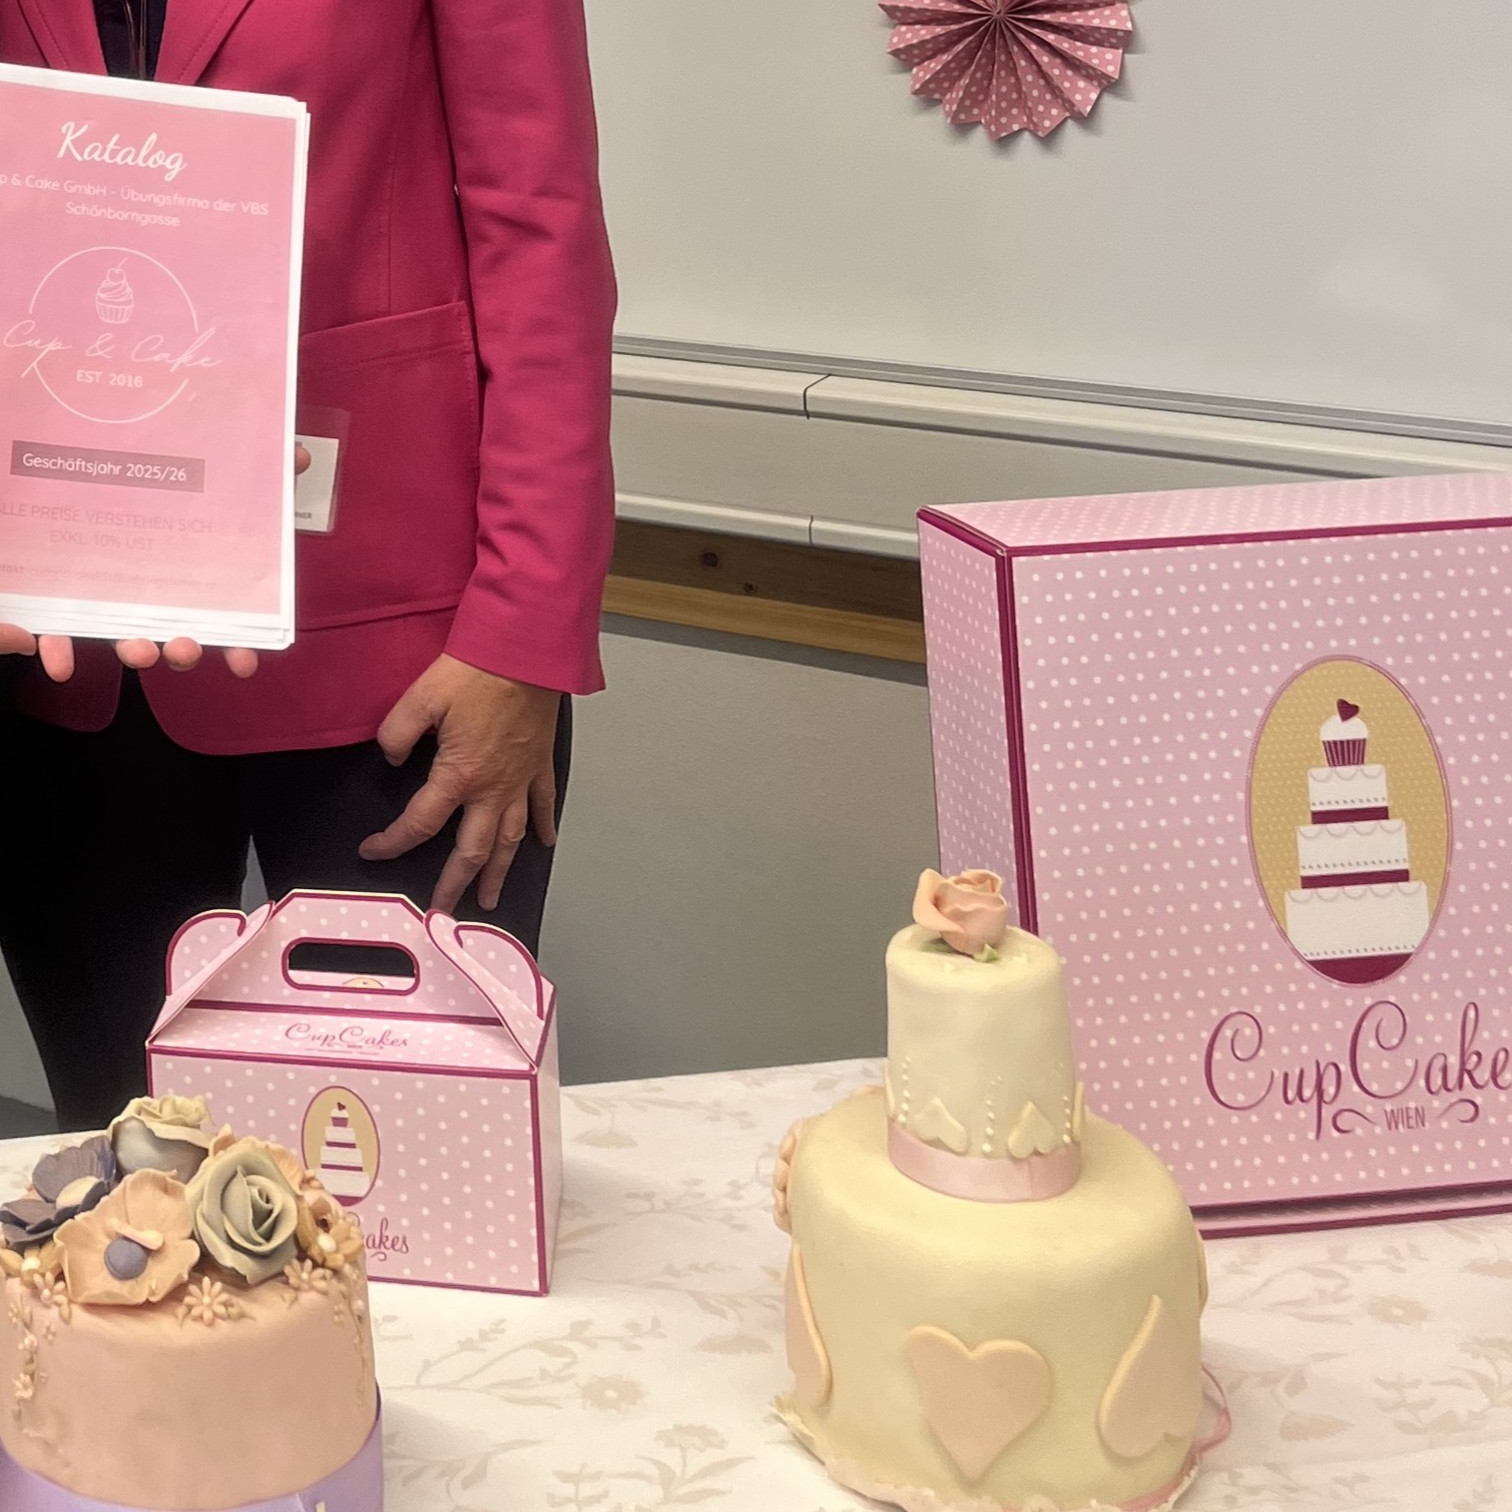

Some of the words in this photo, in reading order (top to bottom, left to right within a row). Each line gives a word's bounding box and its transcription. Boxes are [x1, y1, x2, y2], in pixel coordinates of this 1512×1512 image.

[57, 121, 187, 182] Katalog
[10, 173, 22, 186] &
[25, 175, 60, 190] Cake
[63, 180, 107, 196] GmbH
[120, 185, 210, 208] Übungsfirma
[212, 198, 237, 212] der
[240, 201, 269, 216] VBS
[3, 320, 72, 377] Cup
[85, 333, 116, 359] &
[130, 327, 222, 372] Cake
[108, 373, 143, 388] 2016
[22, 453, 122, 476] Geschäftsjahr
[126, 463, 187, 482] 2025/26
[31, 505, 80, 522] PREISE
[85, 510, 173, 531] VERSTEHEN
[94, 533, 121, 548] 10%
[126, 536, 154, 550] UST
[284, 1022, 408, 1048] CupCakes
[1384, 1106, 1425, 1131] WIEN
